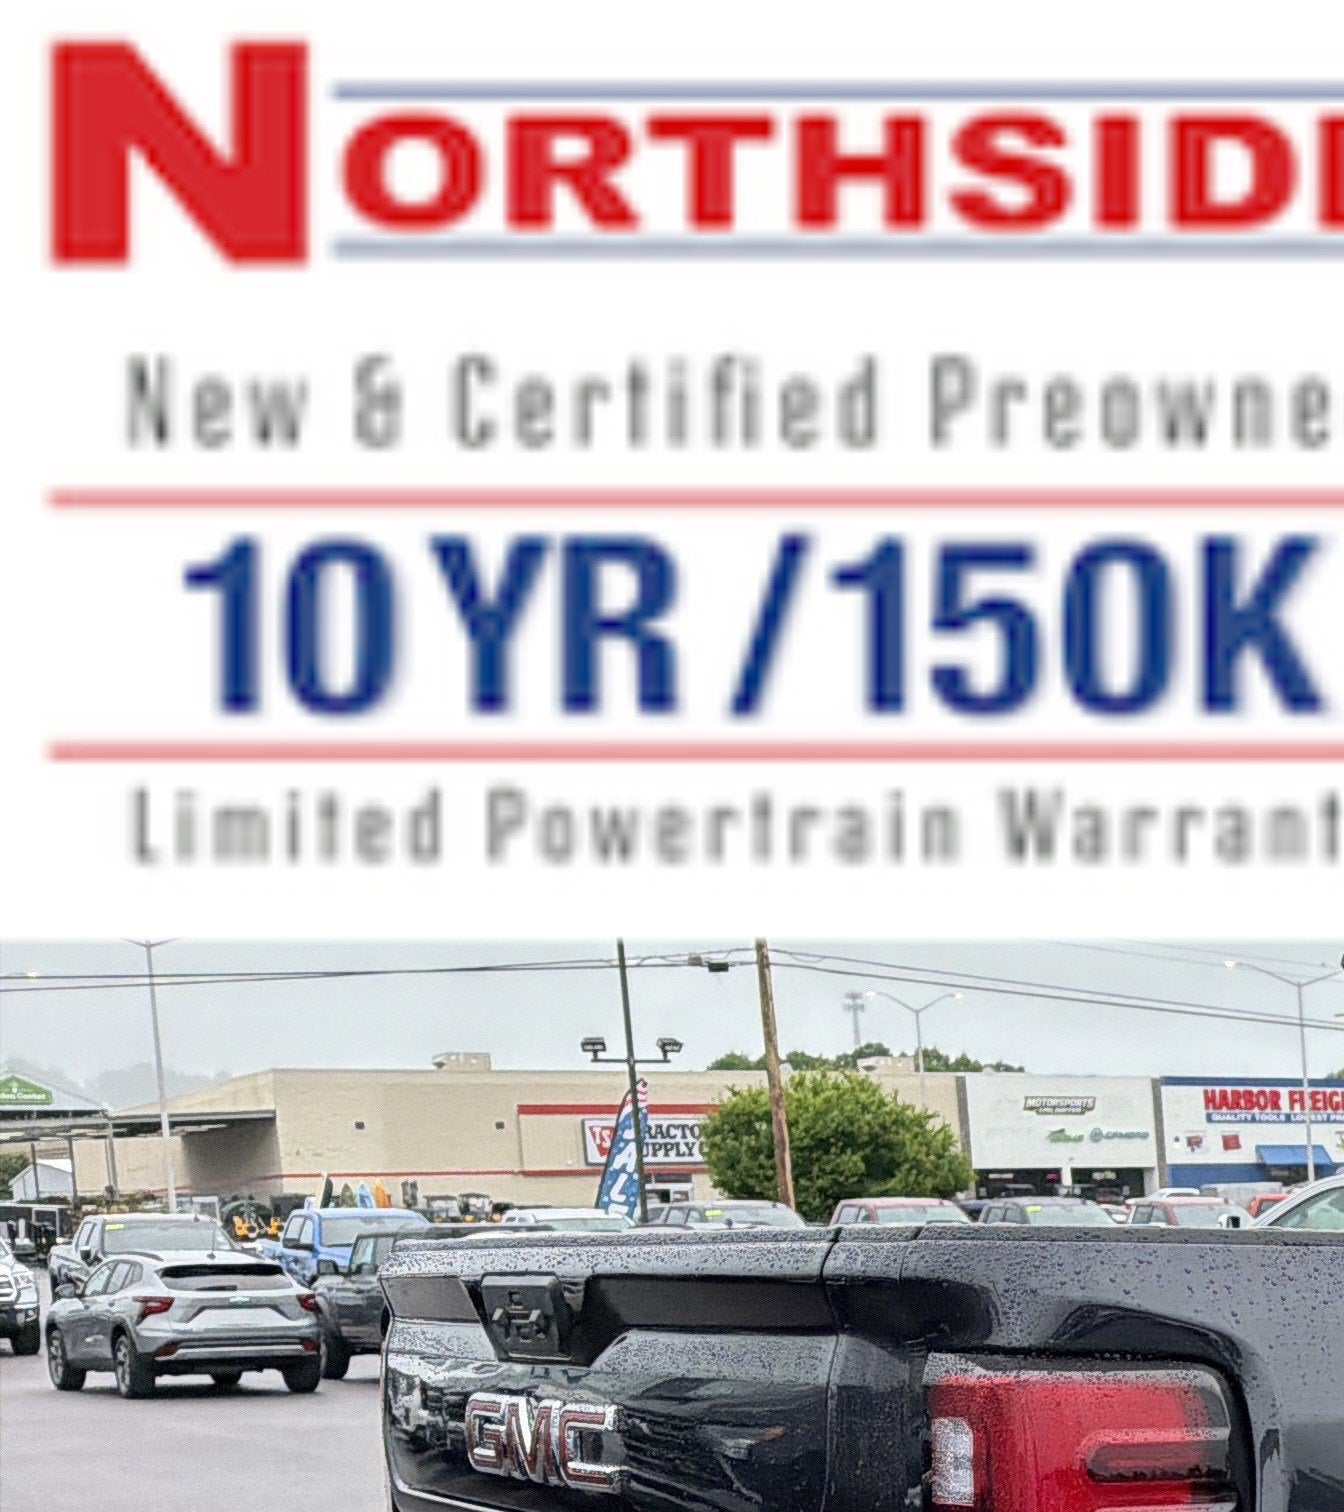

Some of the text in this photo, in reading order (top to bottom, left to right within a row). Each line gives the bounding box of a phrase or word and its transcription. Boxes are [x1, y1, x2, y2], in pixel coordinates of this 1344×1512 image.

[1203, 1088, 1282, 1111] HARBOR
[1211, 1113, 1252, 1122] QUALITY
[1255, 1113, 1286, 1122] TOOLS
[1291, 1113, 1328, 1122] LOEST
[647, 1123, 704, 1140] RACTO
[643, 1142, 696, 1157] UPPLY
[465, 1392, 624, 1494] GMC
